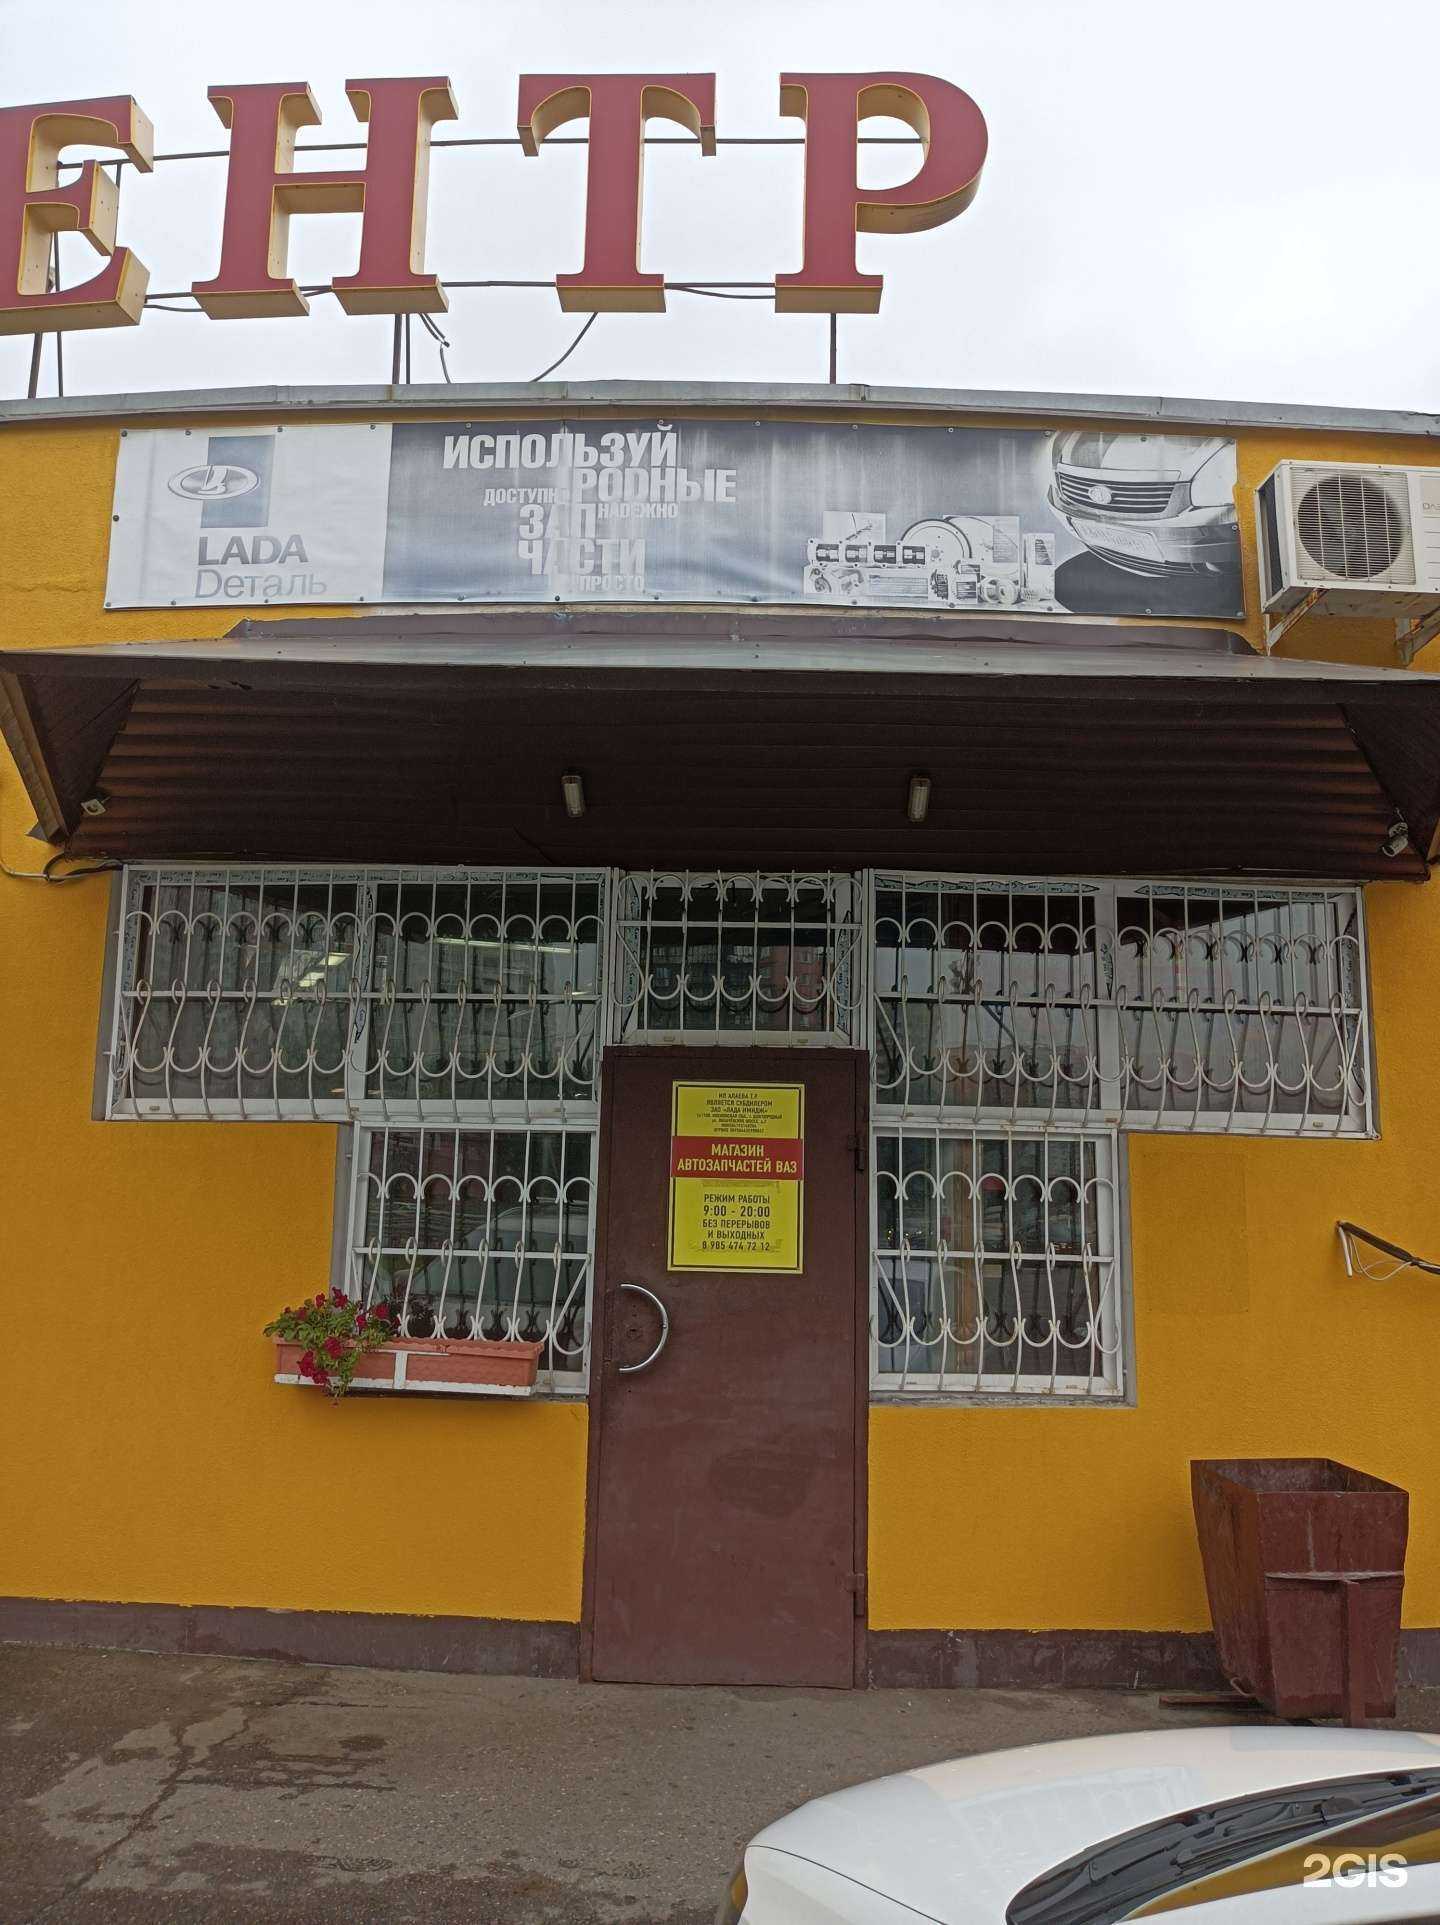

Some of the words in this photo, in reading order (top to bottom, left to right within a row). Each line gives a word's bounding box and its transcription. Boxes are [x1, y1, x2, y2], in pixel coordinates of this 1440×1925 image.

[442, 424, 678, 469] ИСПОЛЬЗУЙ
[198, 534, 309, 566] LADA
[711, 1143, 765, 1157] МАГАЗИН
[677, 1158, 772, 1173] АВТОЗАПЧАСТЕЙ
[776, 1160, 797, 1174] ВАЗ
[704, 1193, 735, 1203] РЕЖИМ
[739, 1194, 770, 1204] РАБОТЫ
[703, 1204, 727, 1217] 9:00
[740, 1205, 770, 1218] 20:00
[702, 1218, 718, 1228] БЕЗ
[720, 1219, 771, 1230] ПЕРЕРЫВОВ
[707, 1230, 714, 1239] И
[716, 1230, 765, 1241] ВЫХОДНЫХ
[702, 1240, 707, 1250] 8
[728, 1240, 744, 1251] 474
[747, 1241, 757, 1251] 72
[760, 1241, 770, 1252] 12
